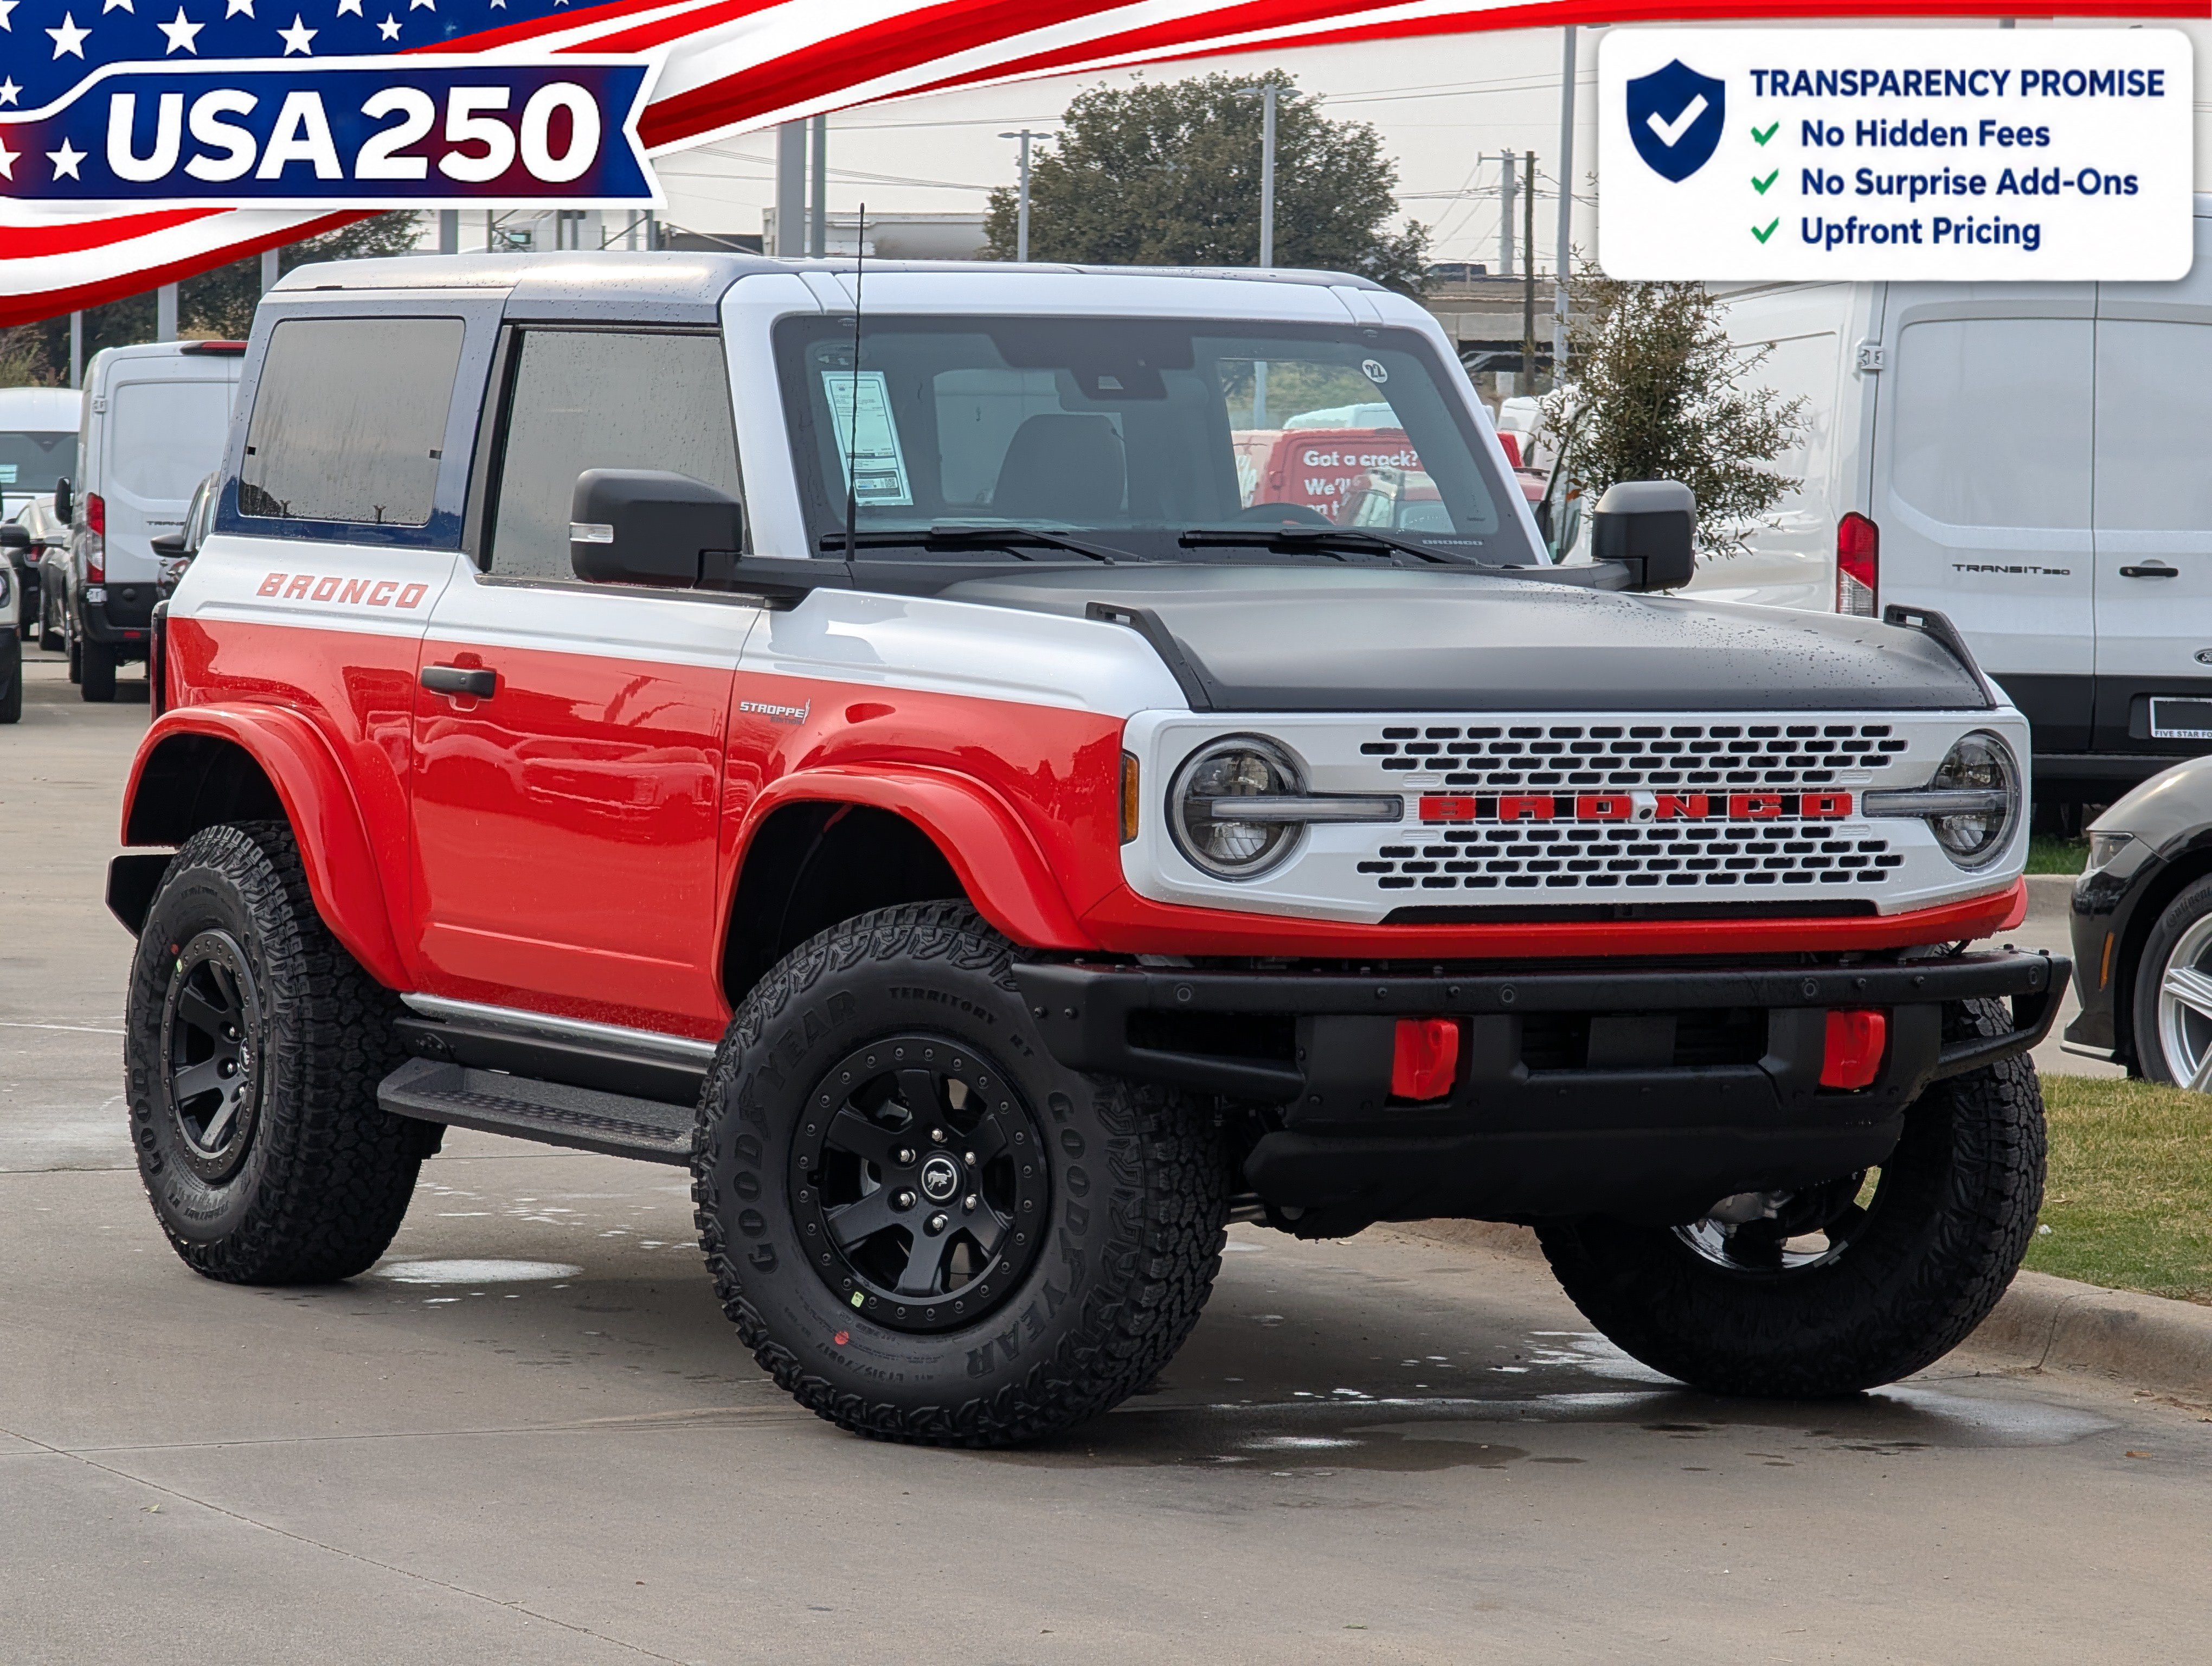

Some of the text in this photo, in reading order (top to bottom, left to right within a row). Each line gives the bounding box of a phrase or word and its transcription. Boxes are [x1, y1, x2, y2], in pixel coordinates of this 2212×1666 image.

[1365, 363, 1386, 378] 22
[1303, 450, 1419, 467] Got a crack?
[256, 573, 429, 608] BRONCO
[1419, 793, 1853, 821] BRONCO
[888, 986, 998, 1024] TERRITORY
